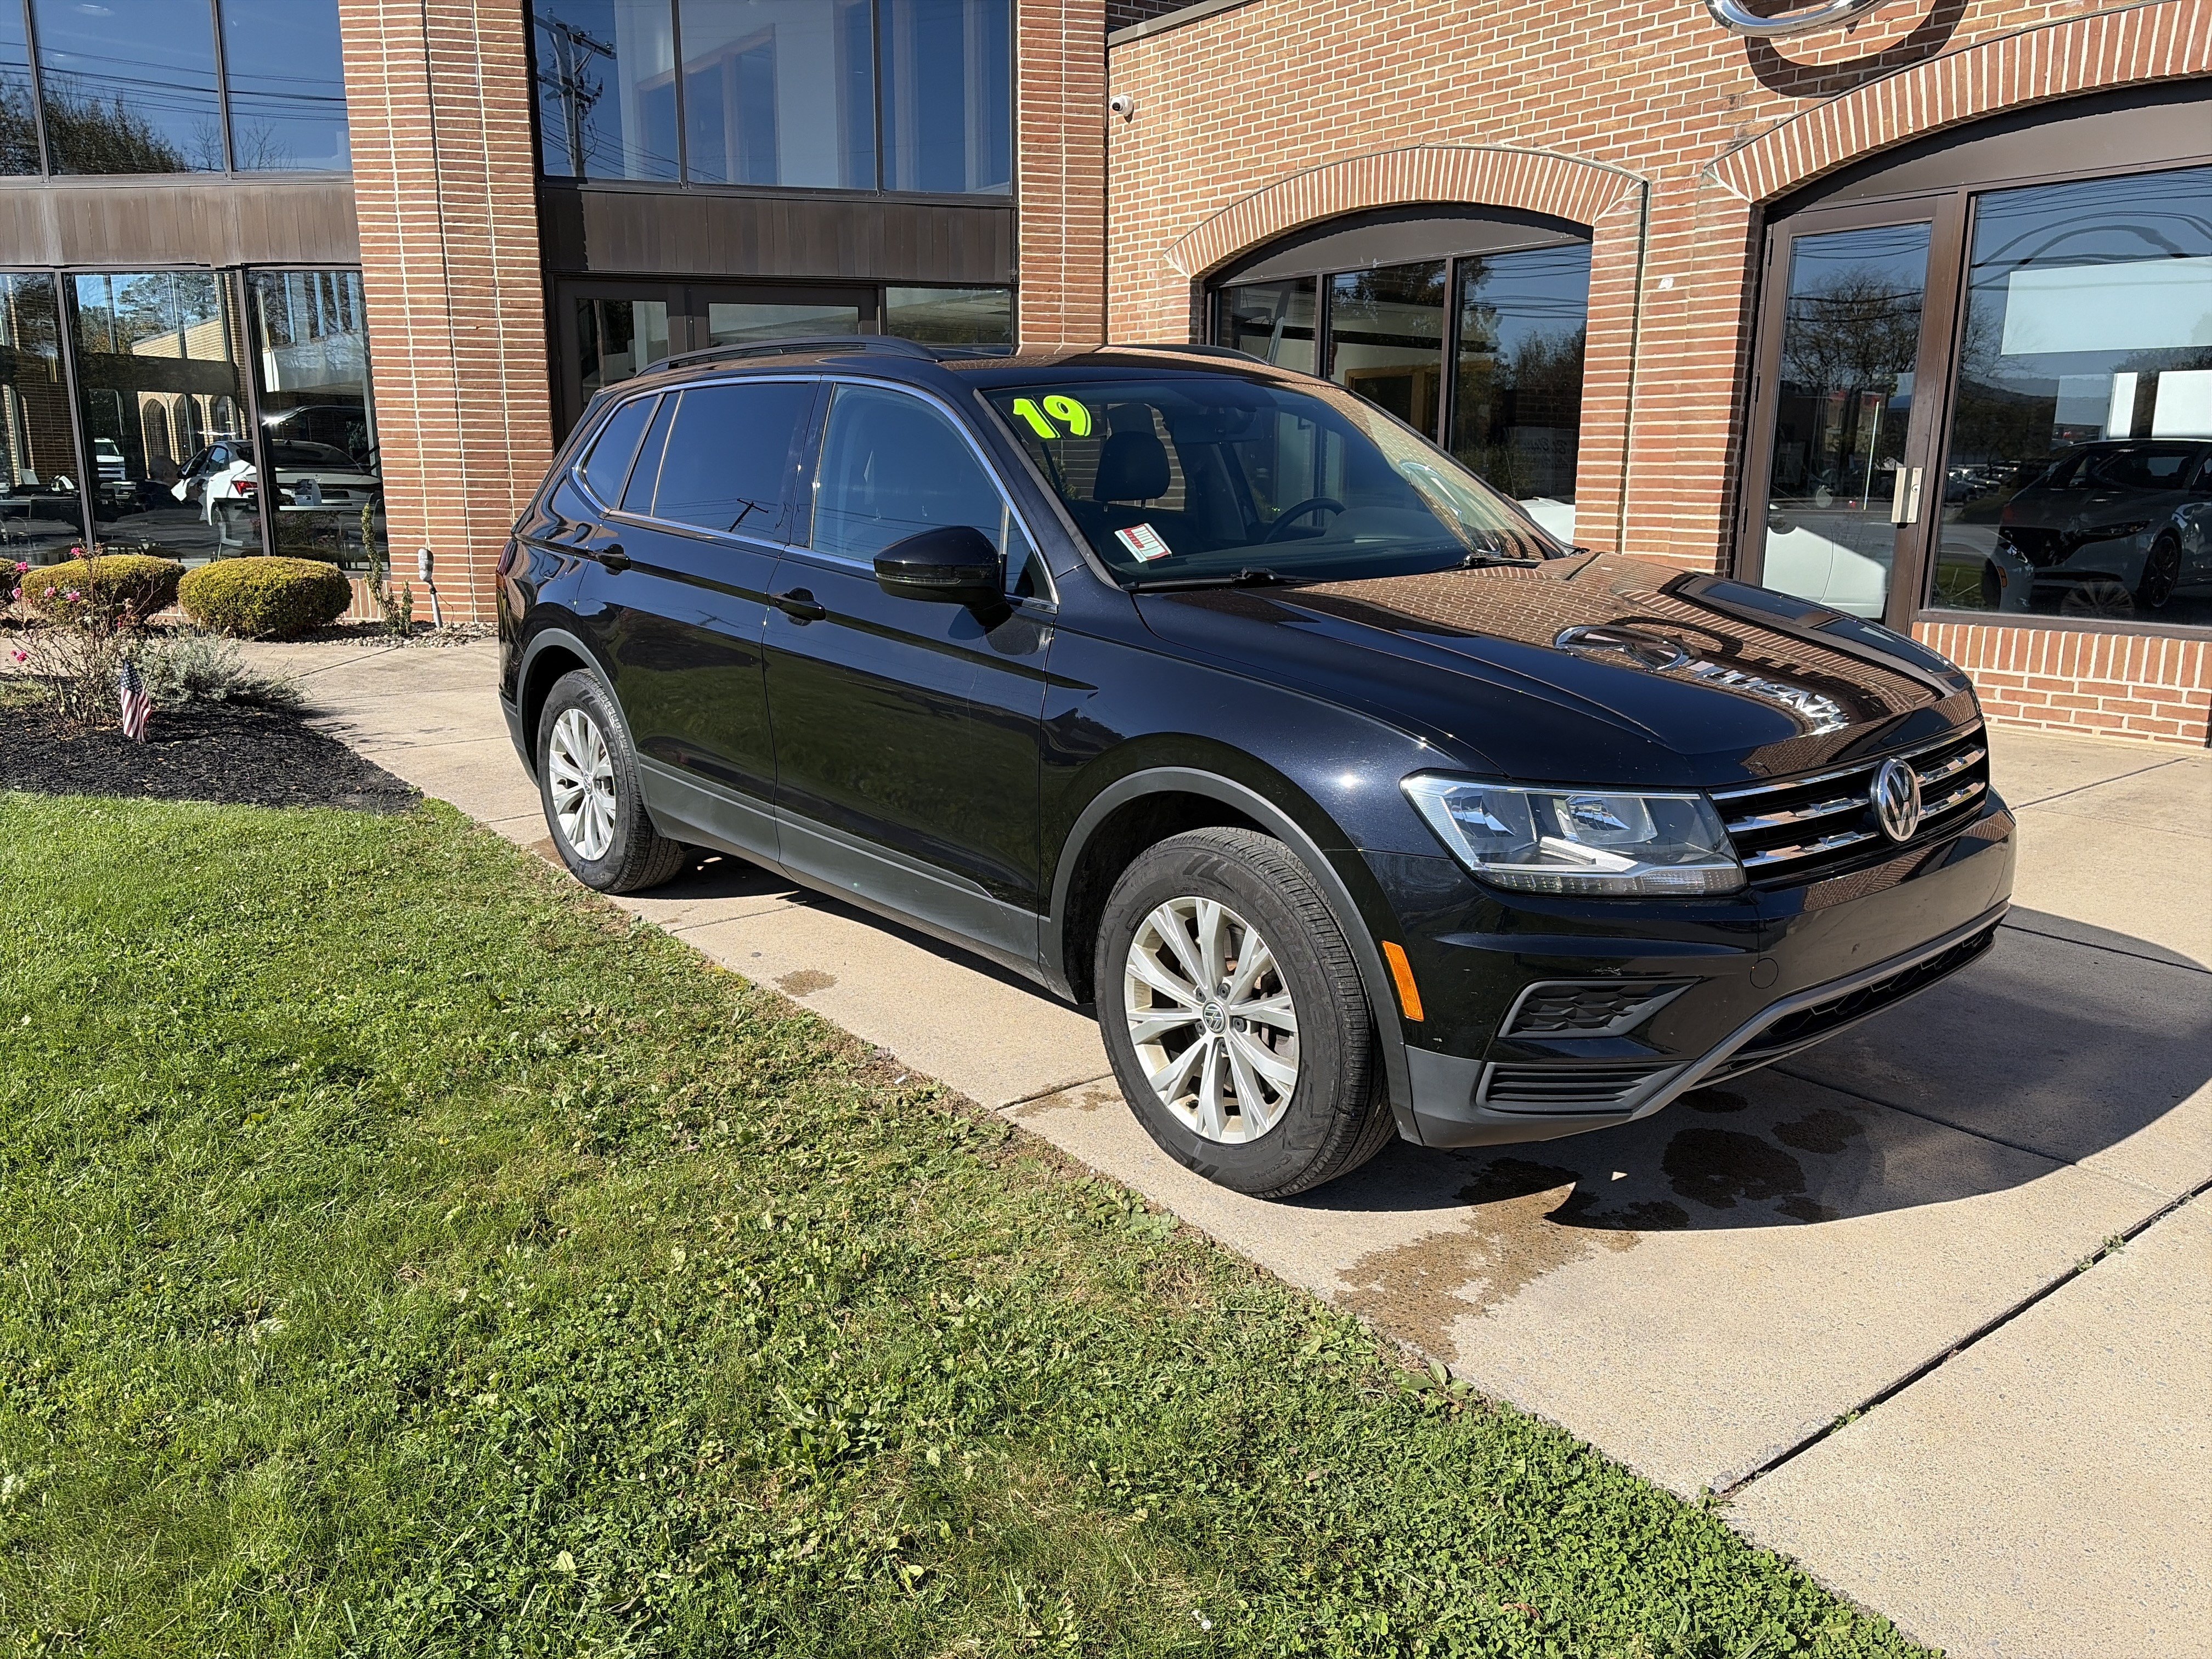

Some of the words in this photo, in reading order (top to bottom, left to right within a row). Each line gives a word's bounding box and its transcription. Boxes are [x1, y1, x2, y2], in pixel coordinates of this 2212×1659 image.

[1013, 395, 1091, 438] 19
[1876, 758, 1921, 842] VW
[1253, 893, 1332, 1063] COOPER
